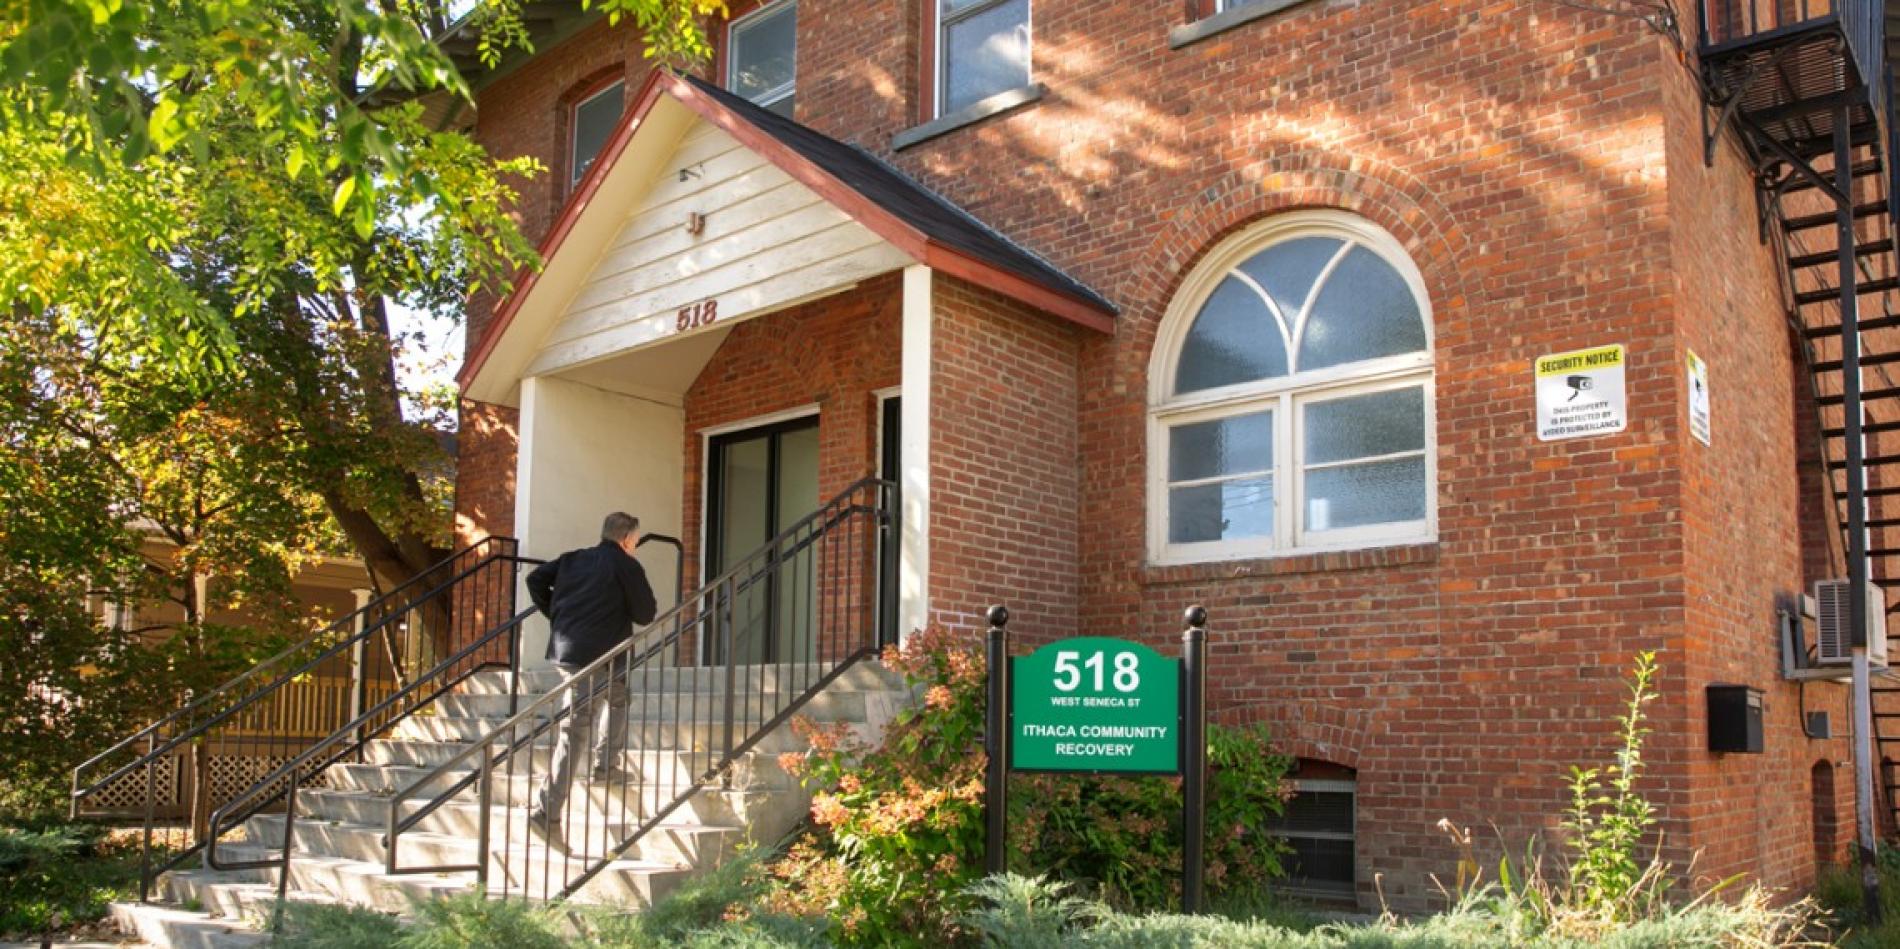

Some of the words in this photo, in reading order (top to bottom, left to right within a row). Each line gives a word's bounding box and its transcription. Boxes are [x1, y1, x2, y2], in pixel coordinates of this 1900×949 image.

[677, 299, 717, 331] 518
[1541, 356, 1584, 373] SECURITY
[1586, 349, 1619, 366] NOTICE
[1571, 401, 1609, 413] PROPERTY
[1559, 413, 1601, 425] PROTECTED
[1543, 426, 1566, 436] VIDEO
[1566, 419, 1621, 433] SURVEILLANCE
[1052, 650, 1141, 693] 518
[1051, 696, 1081, 707] WEST
[1083, 697, 1126, 708] SENECA
[1127, 698, 1141, 708] ST
[1023, 724, 1077, 738] ITHACA
[1079, 725, 1168, 739] COMMUNITY
[1055, 743, 1135, 756] RECOVERY
